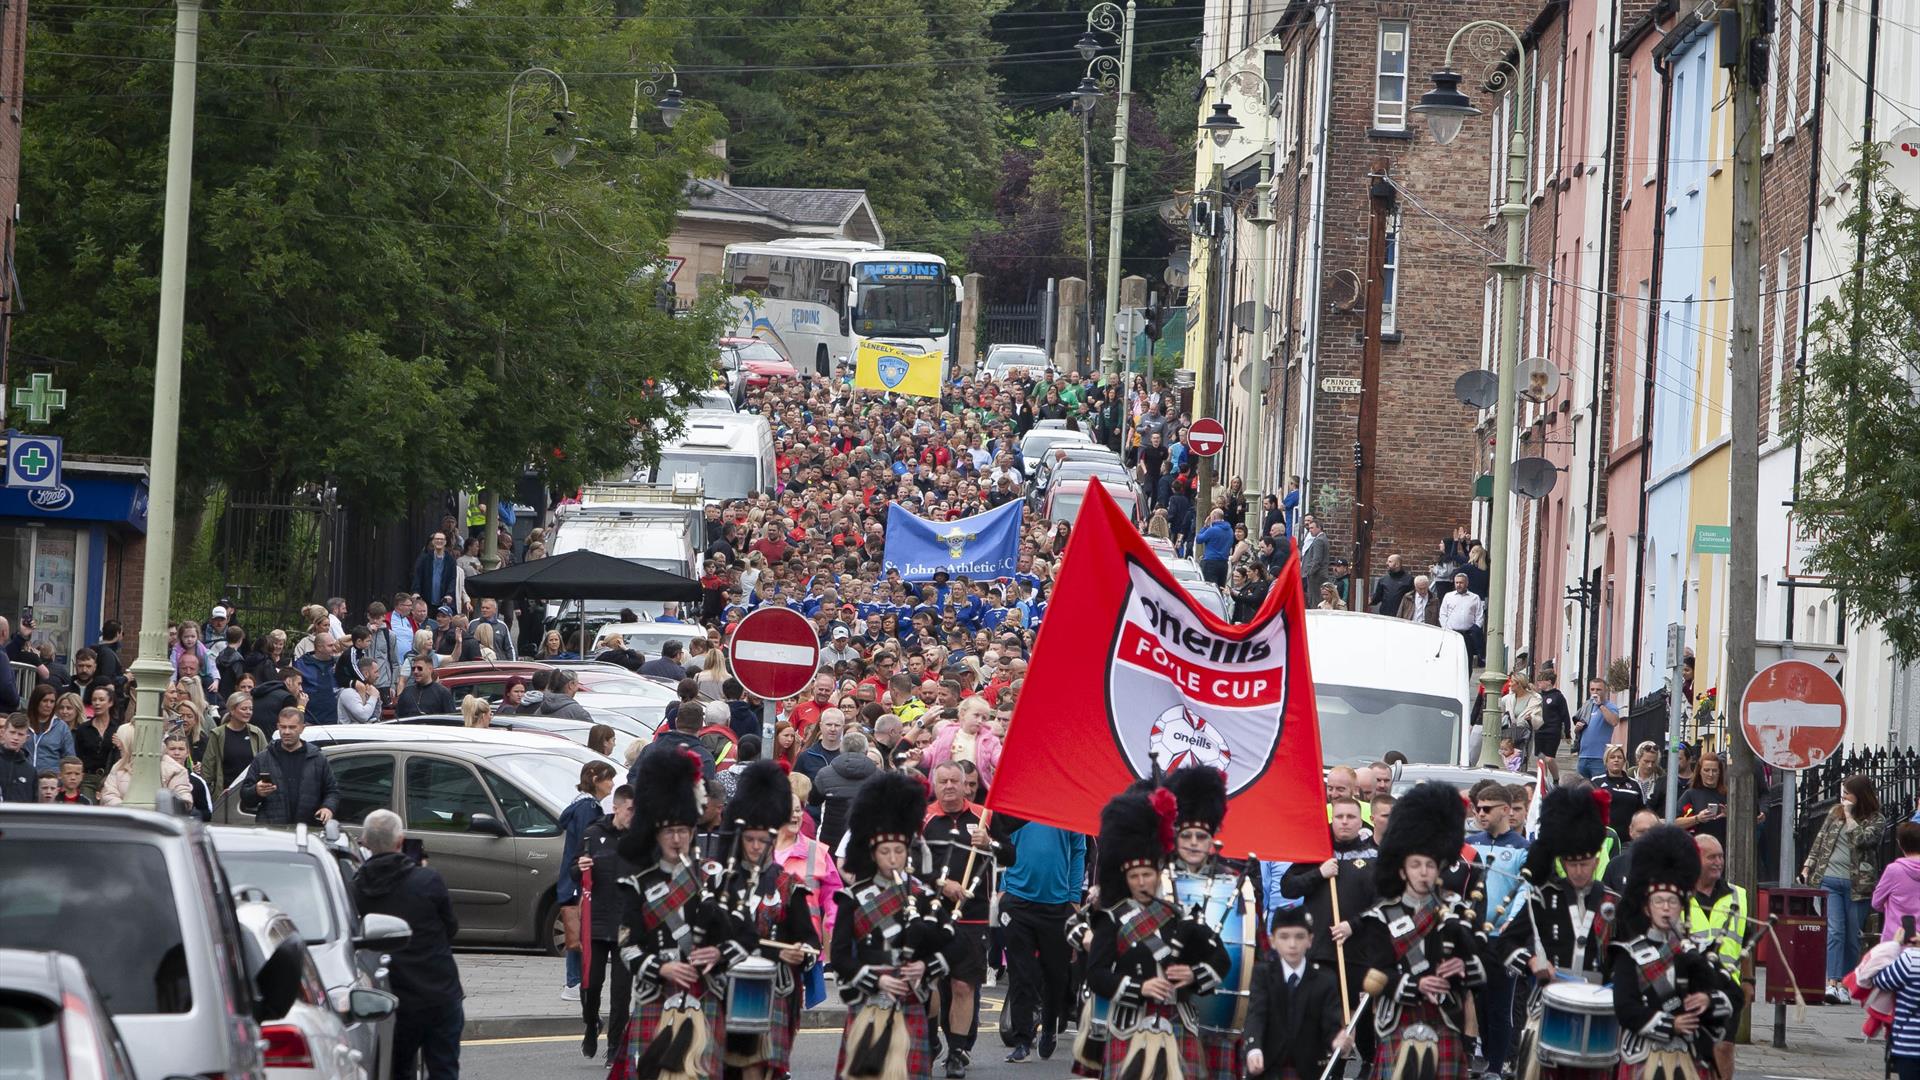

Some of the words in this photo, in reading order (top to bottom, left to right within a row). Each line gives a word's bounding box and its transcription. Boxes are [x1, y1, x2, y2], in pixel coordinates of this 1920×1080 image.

[863, 264, 939, 281] REDDINS
[791, 308, 820, 331] REDDINS
[947, 561, 996, 574] Athletic
[1136, 637, 1201, 692] FOLE
[1212, 679, 1268, 700] CUP
